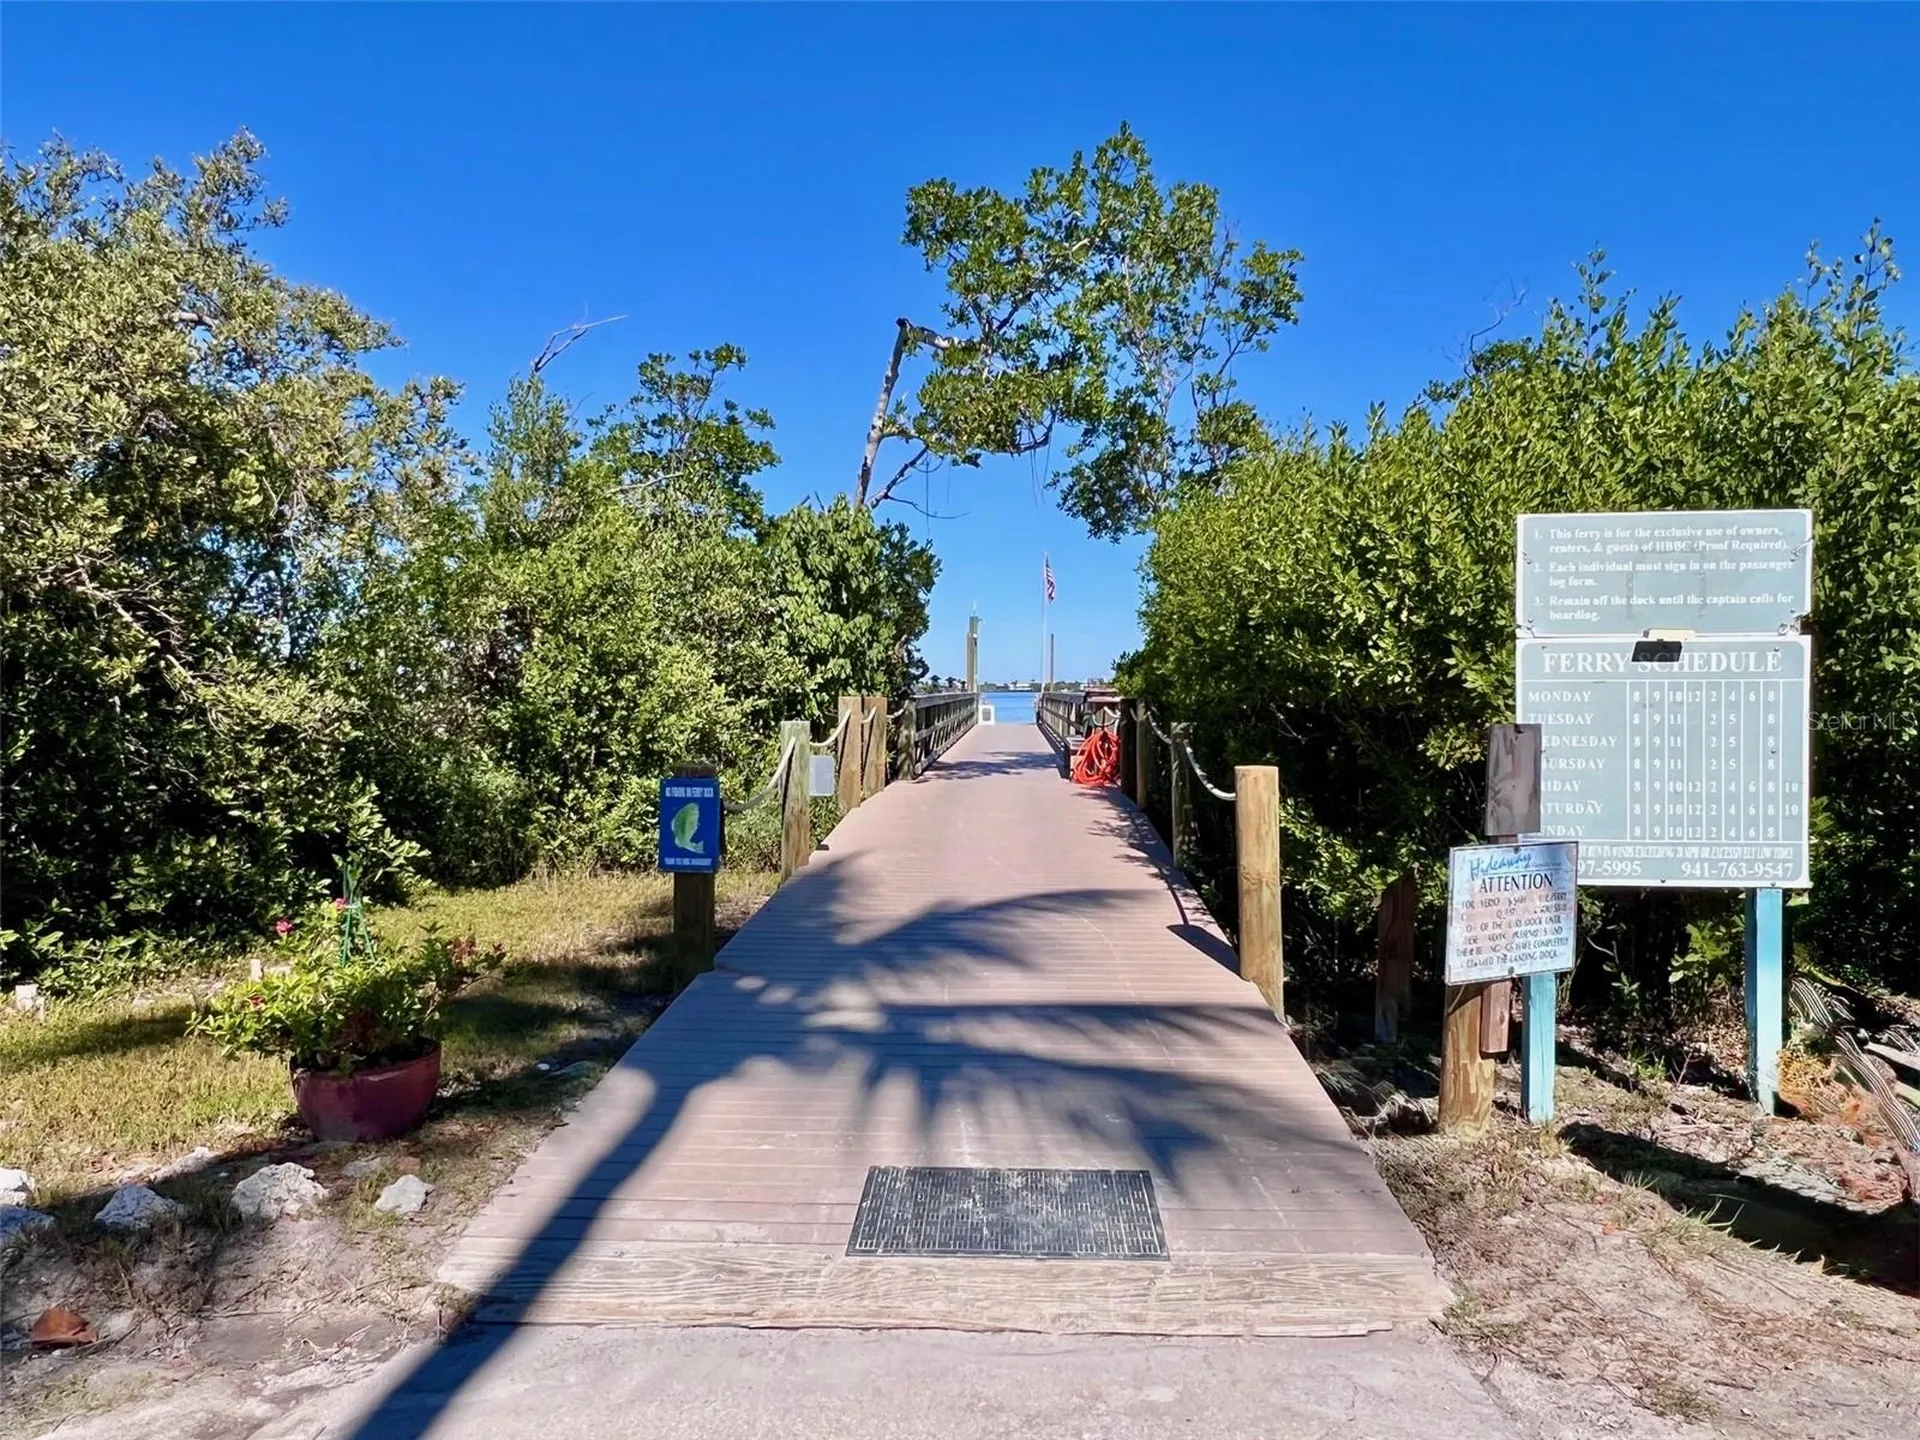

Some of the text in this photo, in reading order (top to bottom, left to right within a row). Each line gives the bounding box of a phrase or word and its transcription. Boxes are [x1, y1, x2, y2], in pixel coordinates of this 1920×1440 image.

[1549, 528, 1572, 539] This
[1575, 528, 1600, 540] ferry
[1604, 528, 1612, 538] is
[1616, 527, 1632, 538] for
[1635, 528, 1652, 538] the
[1654, 526, 1702, 538] exclusive
[1706, 527, 1724, 537] use
[1726, 526, 1738, 536] of
[1593, 542, 1604, 553] &
[1606, 542, 1638, 555] guests
[1641, 541, 1654, 552] of
[1694, 540, 1728, 552] (Proof
[1549, 562, 1576, 572] Each
[1580, 560, 1632, 572] individual
[1636, 561, 1662, 571] must
[1664, 560, 1686, 574] sign
[1690, 560, 1700, 570] in
[1703, 562, 1716, 570] on
[1720, 560, 1736, 570] the
[1740, 560, 1794, 572] passenger
[1550, 576, 1598, 588] log form.
[1549, 596, 1590, 606] Remain
[1593, 595, 1608, 606] off
[1611, 595, 1627, 606] the
[1630, 594, 1656, 606] dock
[1659, 595, 1684, 605] until
[1687, 594, 1704, 604] the
[1706, 593, 1746, 606] captain
[1750, 594, 1774, 604] calls
[1778, 593, 1794, 604] for
[1543, 652, 1782, 672] FERRY SCHEDULE
[1528, 690, 1775, 702] MONDAY 8 9 10 12 2 4 6 8
[1527, 712, 1775, 724] TUESDAY 8 9 11 2 5 8
[1542, 735, 1775, 747] EDNESDAY 8 9 11 2 5 8
[1542, 758, 1775, 770] URSDAY 8 9 11 2 5 8
[1634, 780, 1640, 792] 8
[1653, 780, 1660, 792] 9
[1669, 781, 1682, 792] 10
[1688, 781, 1700, 792] 12
[1710, 781, 1718, 792] 2
[1728, 781, 1736, 792] 4
[1748, 781, 1756, 792] 6
[1768, 781, 1775, 792] 8
[1785, 781, 1798, 792] 10
[1541, 802, 1798, 815] TURDAY 8 9 10 12 2 4 6 8 10
[1541, 825, 1775, 838] NDAY 8 9 10 12 2 4 6 8
[1681, 862, 1794, 878] 941-763-9547
[1479, 872, 1554, 894] ATTENTION
